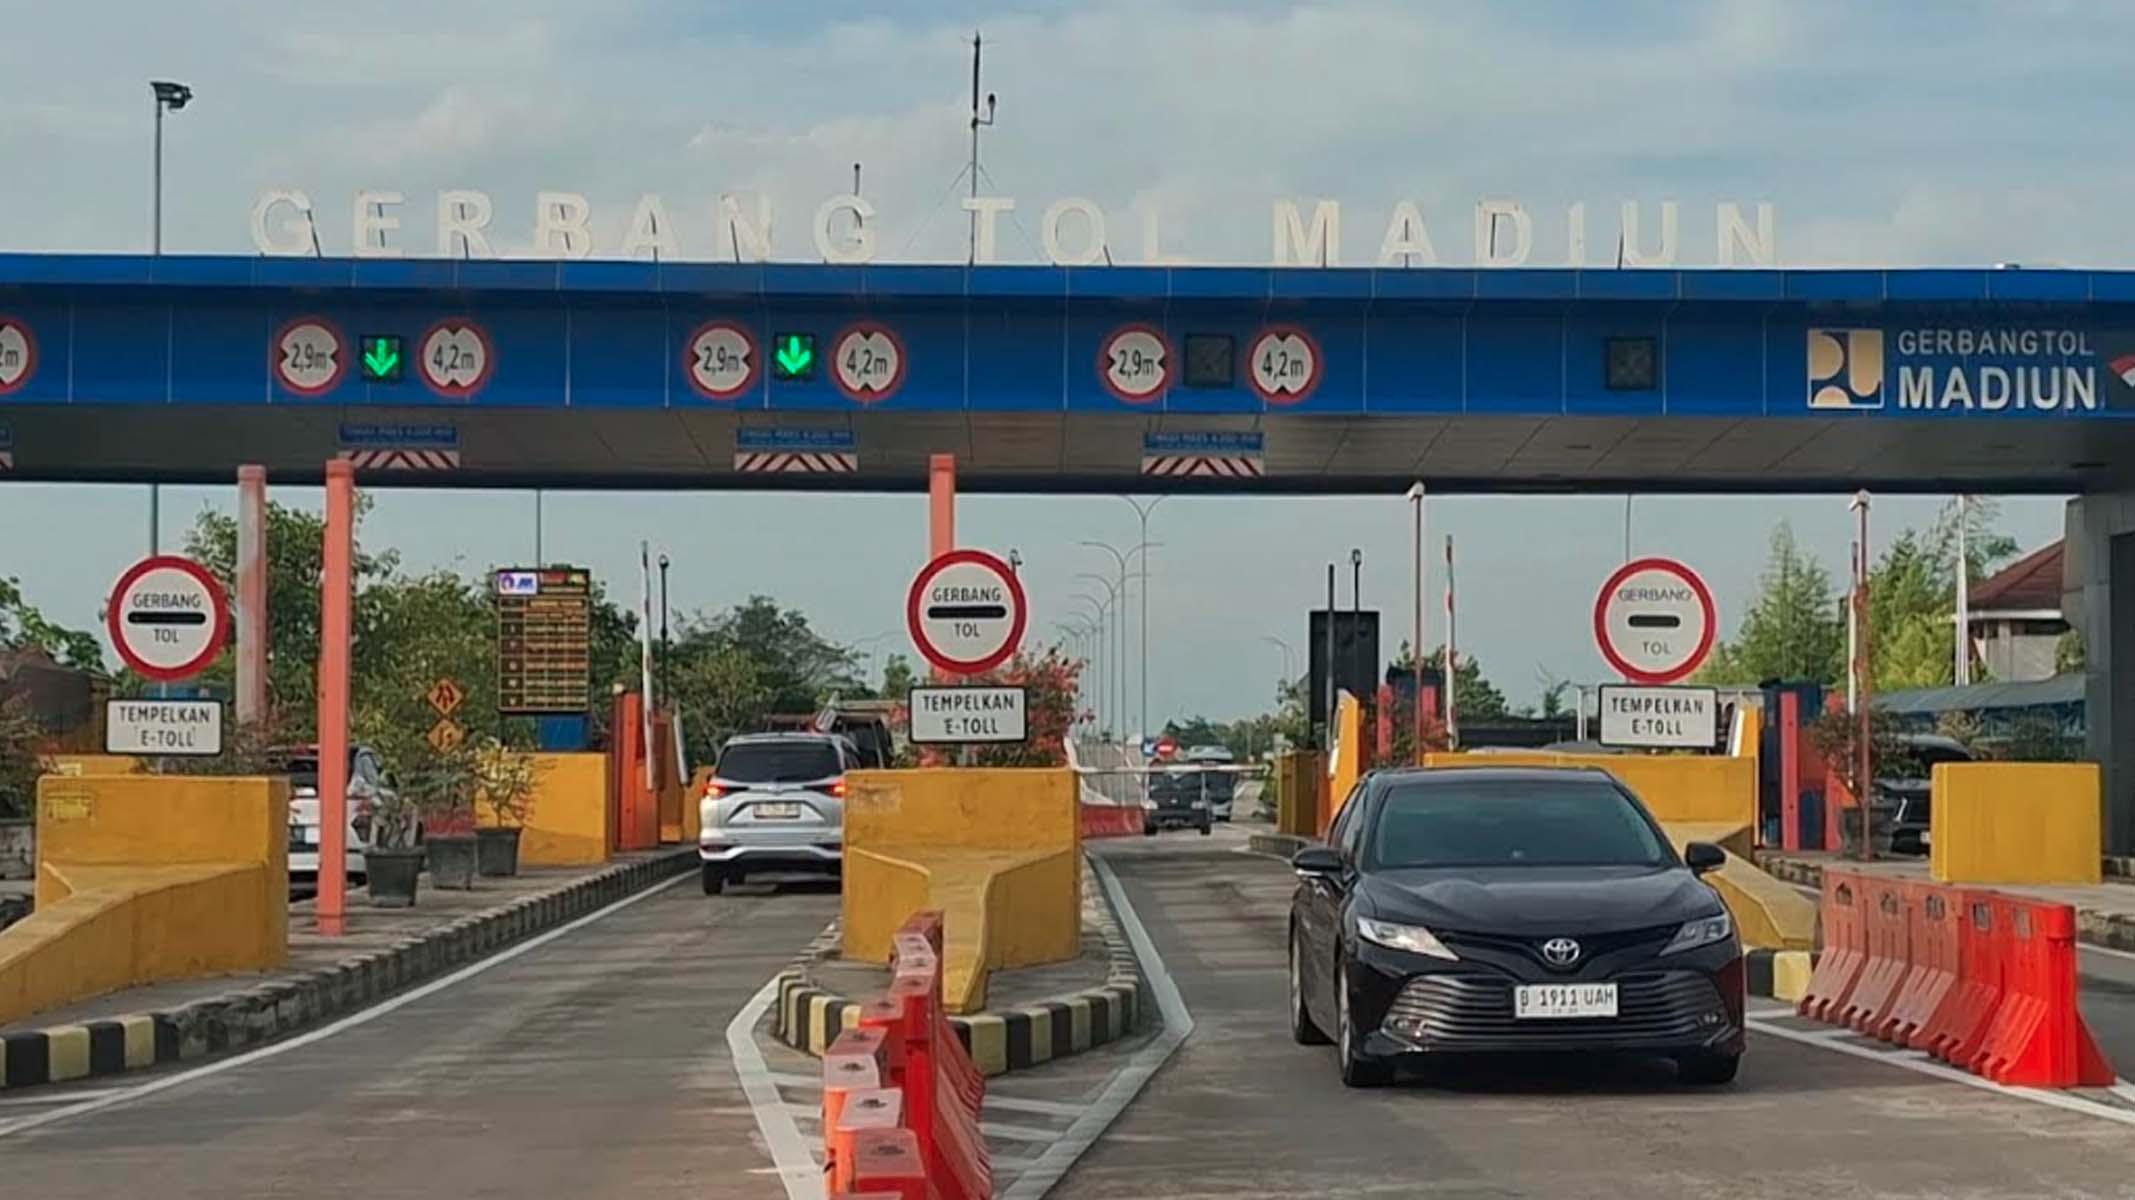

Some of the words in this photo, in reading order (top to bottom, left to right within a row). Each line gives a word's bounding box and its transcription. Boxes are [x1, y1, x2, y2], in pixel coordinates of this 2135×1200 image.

[252, 190, 878, 264] GERBANG
[962, 196, 1188, 266] TOL
[1272, 199, 1776, 268] MADIUN
[1898, 328, 2095, 356] GERBANGTOL
[291, 344, 328, 373] 2,9m
[433, 345, 475, 374] 4,2m
[703, 346, 740, 375] 2,9m
[846, 350, 888, 379] 4,2m
[1119, 350, 1154, 379] 2,9m
[1262, 352, 1304, 381] 4,2m
[1898, 366, 2097, 410] MADIUN
[132, 593, 201, 609] GERBANG
[932, 588, 1001, 603] GERBANG
[1618, 588, 1692, 602] GERBANG
[154, 628, 179, 643] TOL
[954, 623, 980, 638] TOL
[1642, 641, 1671, 656] TOL
[922, 695, 1015, 712] TEMPELKAN
[1612, 697, 1703, 715] TEMPELKAN
[119, 705, 210, 724] TEMPELKAN
[1631, 719, 1682, 736] E-TOLL
[1520, 990, 1529, 1007] B
[1540, 989, 1577, 1006] 1911
[1584, 988, 1614, 1006] UAH
